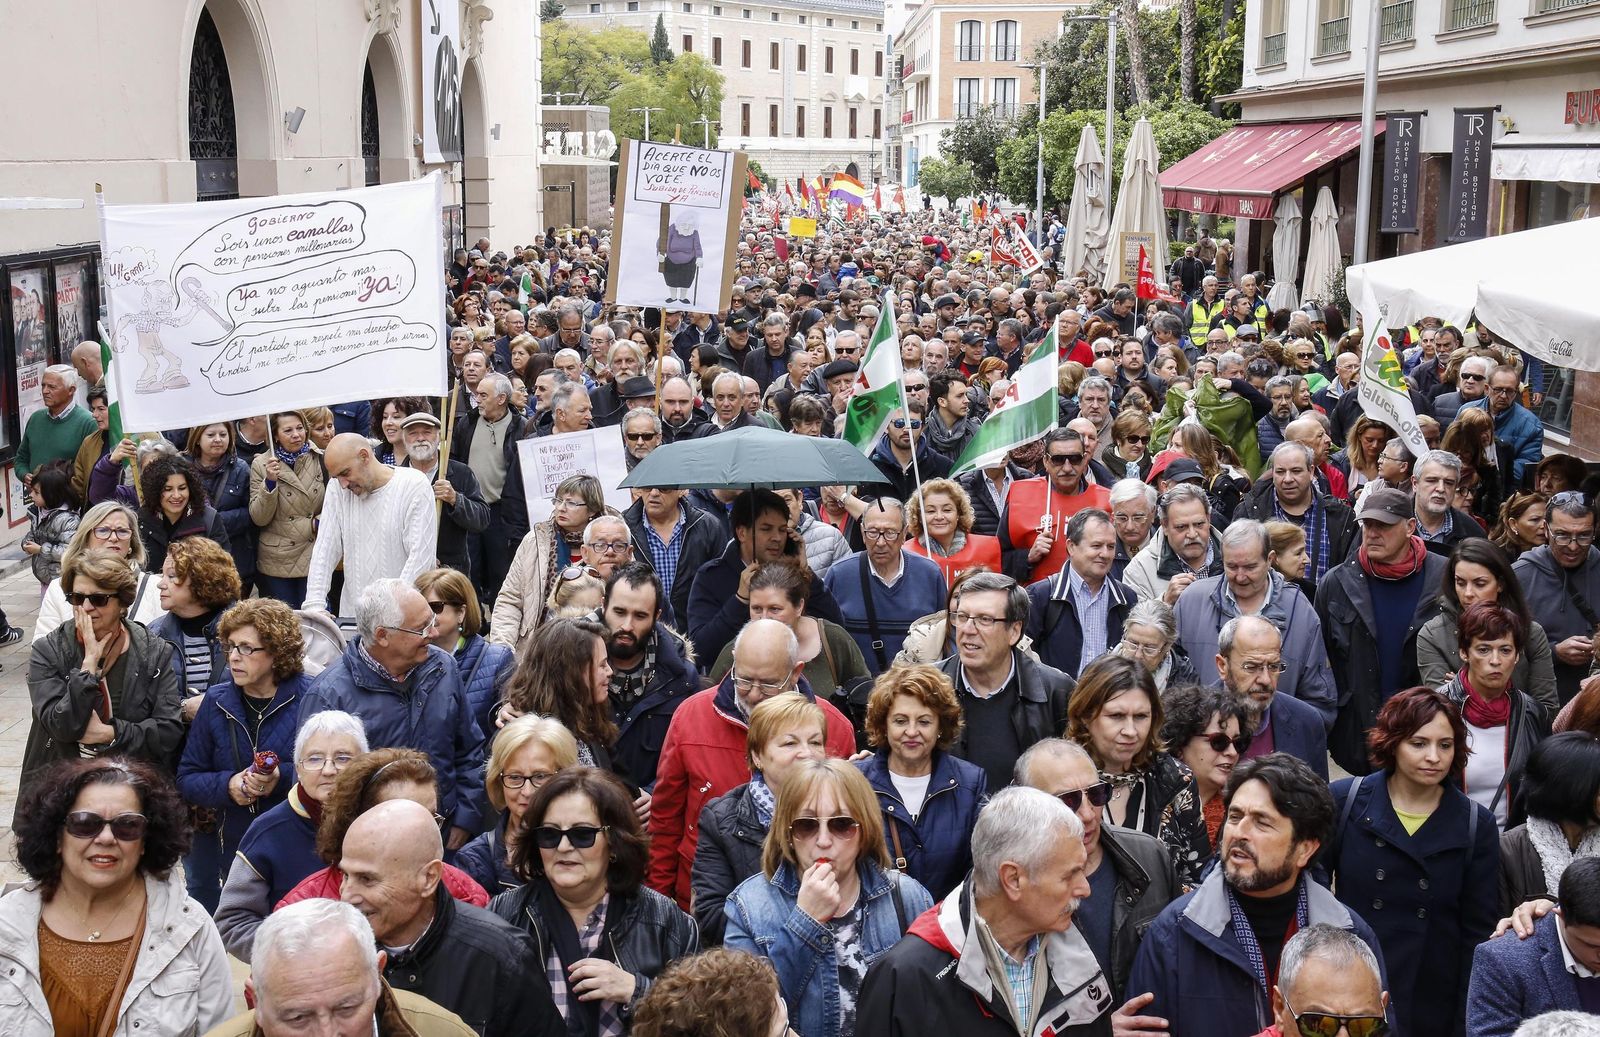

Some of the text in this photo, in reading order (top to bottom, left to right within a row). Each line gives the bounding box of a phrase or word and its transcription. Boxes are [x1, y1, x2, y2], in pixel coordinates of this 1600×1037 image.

[698, 153, 712, 164] EL
[662, 164, 687, 173] QUE
[690, 165, 709, 177] NO
[709, 168, 722, 178] OS
[1239, 199, 1254, 215] TAPAS
[214, 217, 354, 253] Sois unos canallas
[213, 257, 239, 267] con
[267, 285, 287, 296] no
[291, 266, 348, 297] aguanto
[288, 297, 309, 311] las
[366, 339, 380, 347] en
[383, 332, 398, 345] las
[248, 336, 290, 364] partido
[545, 482, 558, 493] EST
